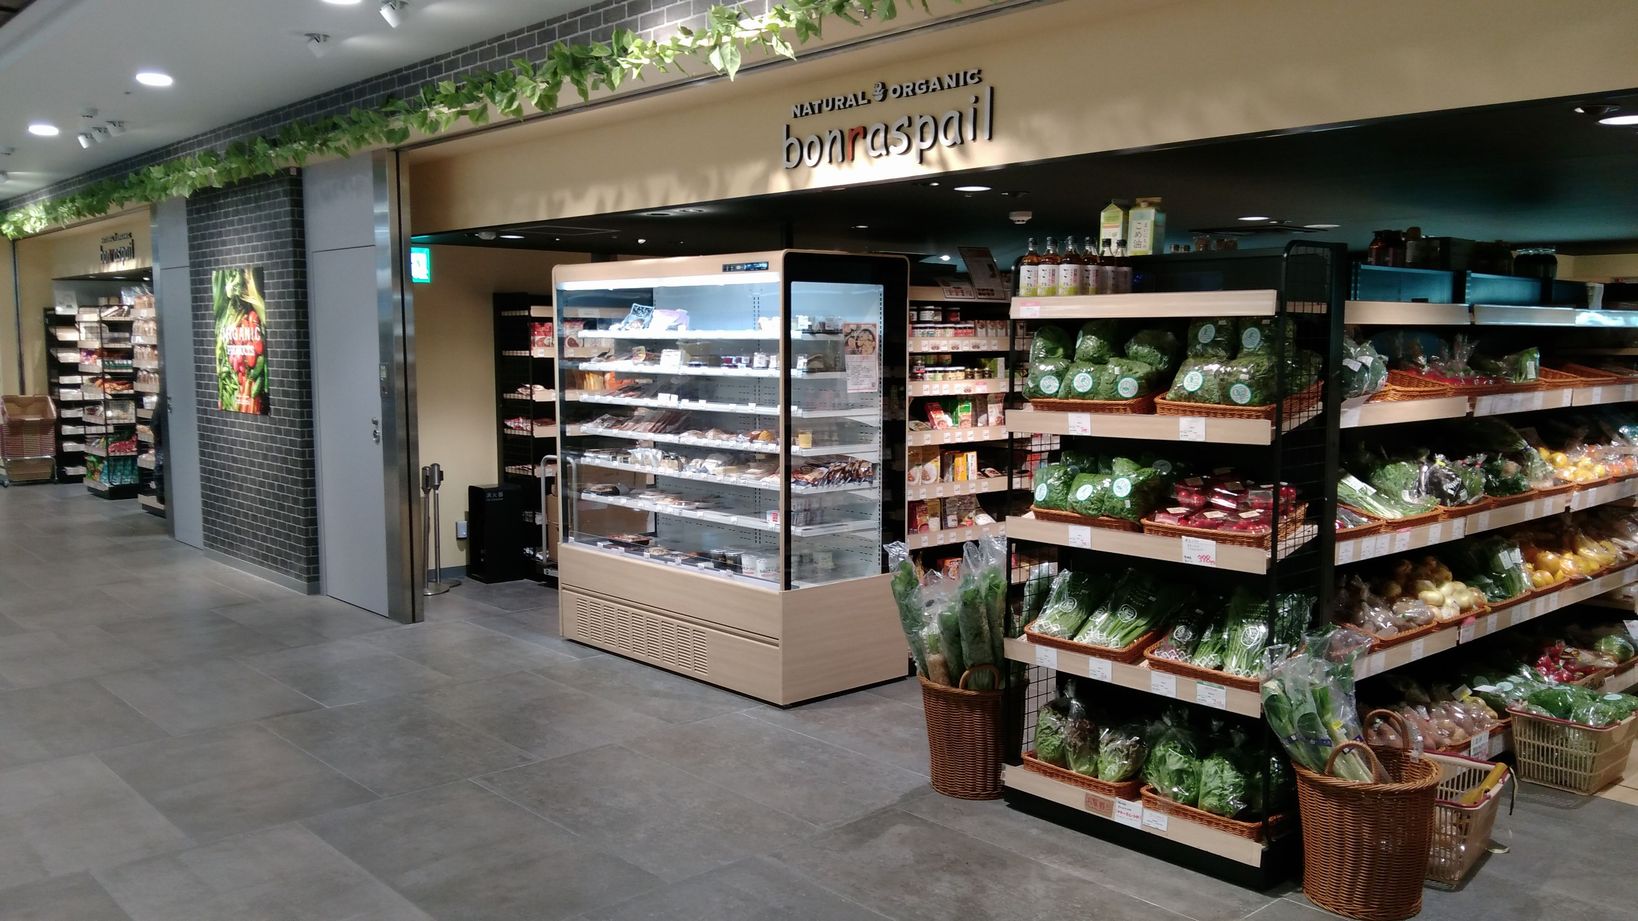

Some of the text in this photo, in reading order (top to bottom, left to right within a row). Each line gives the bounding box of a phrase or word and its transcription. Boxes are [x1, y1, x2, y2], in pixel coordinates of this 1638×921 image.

[791, 91, 870, 118] NATURAL
[890, 69, 982, 99] ORGANIC
[782, 86, 994, 169] bonraspail
